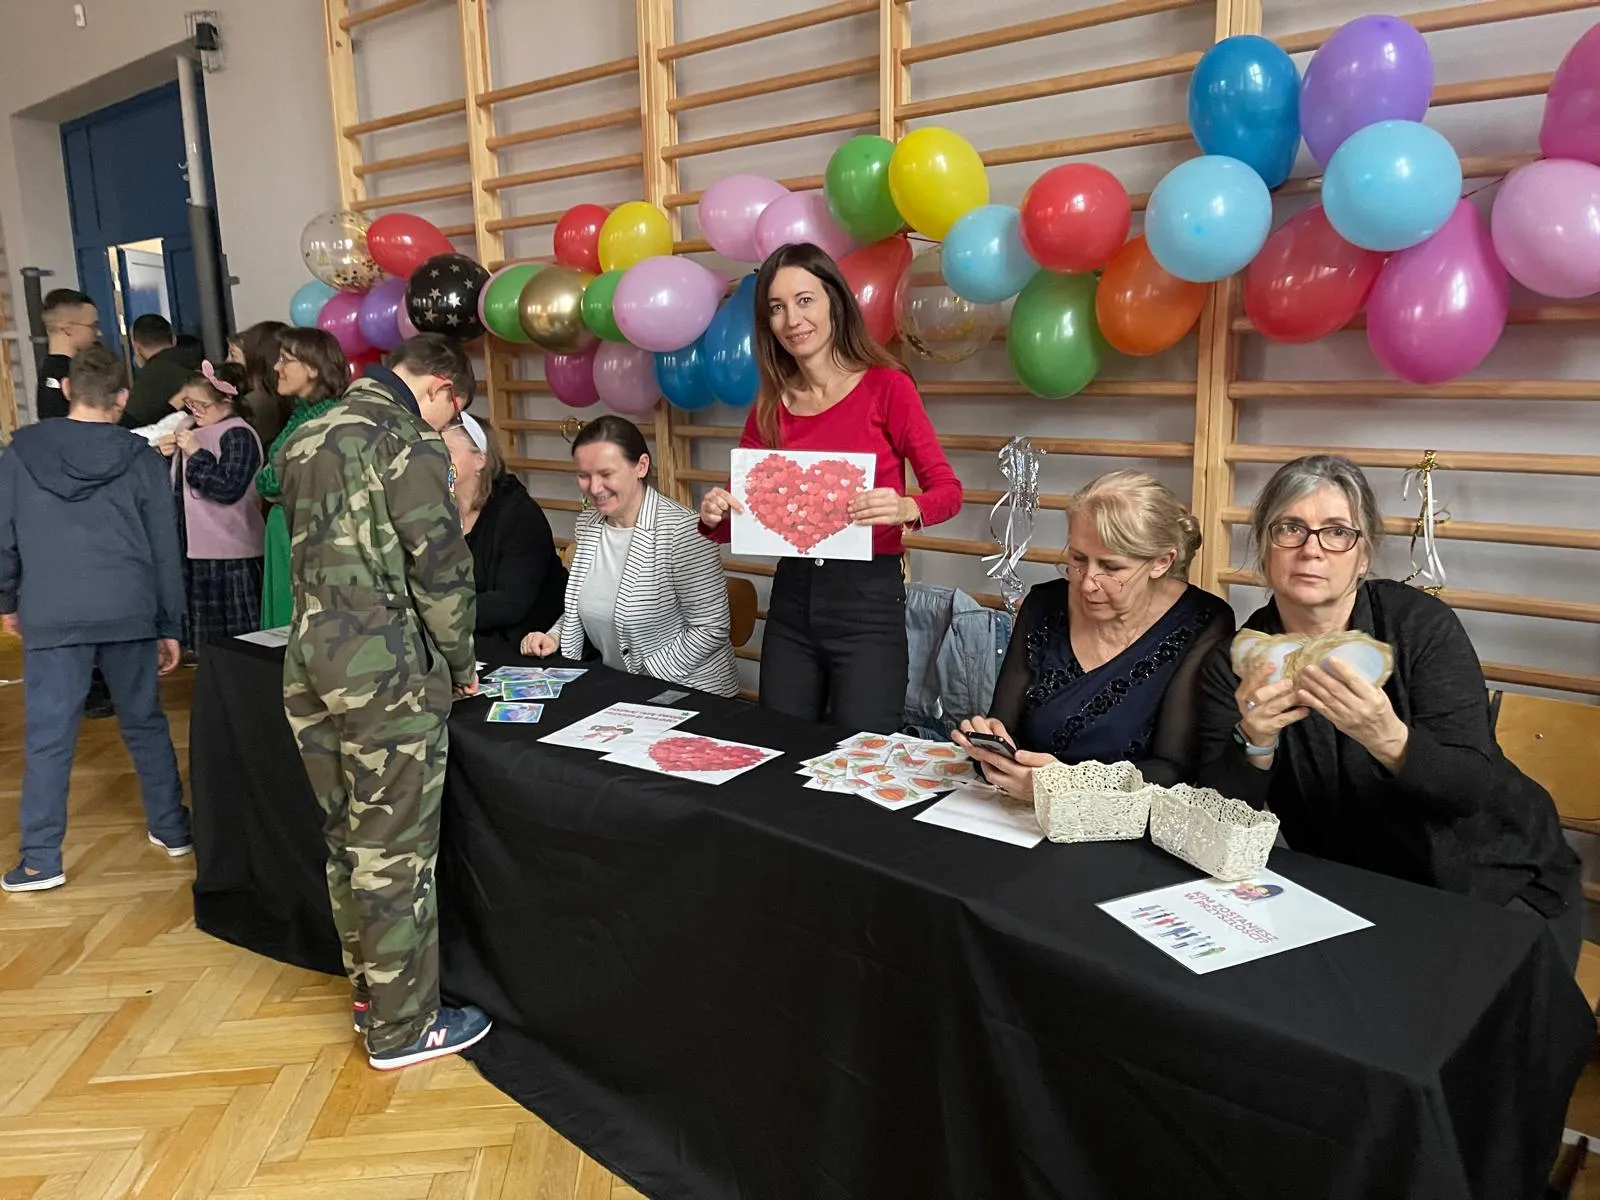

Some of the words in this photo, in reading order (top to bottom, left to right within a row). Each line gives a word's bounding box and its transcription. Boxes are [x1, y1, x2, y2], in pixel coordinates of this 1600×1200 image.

[1184, 892, 1197, 901] W
[1192, 891, 1216, 904] KIM
[1212, 903, 1279, 942] ZOSTANIESZ
[425, 1028, 447, 1048] N
